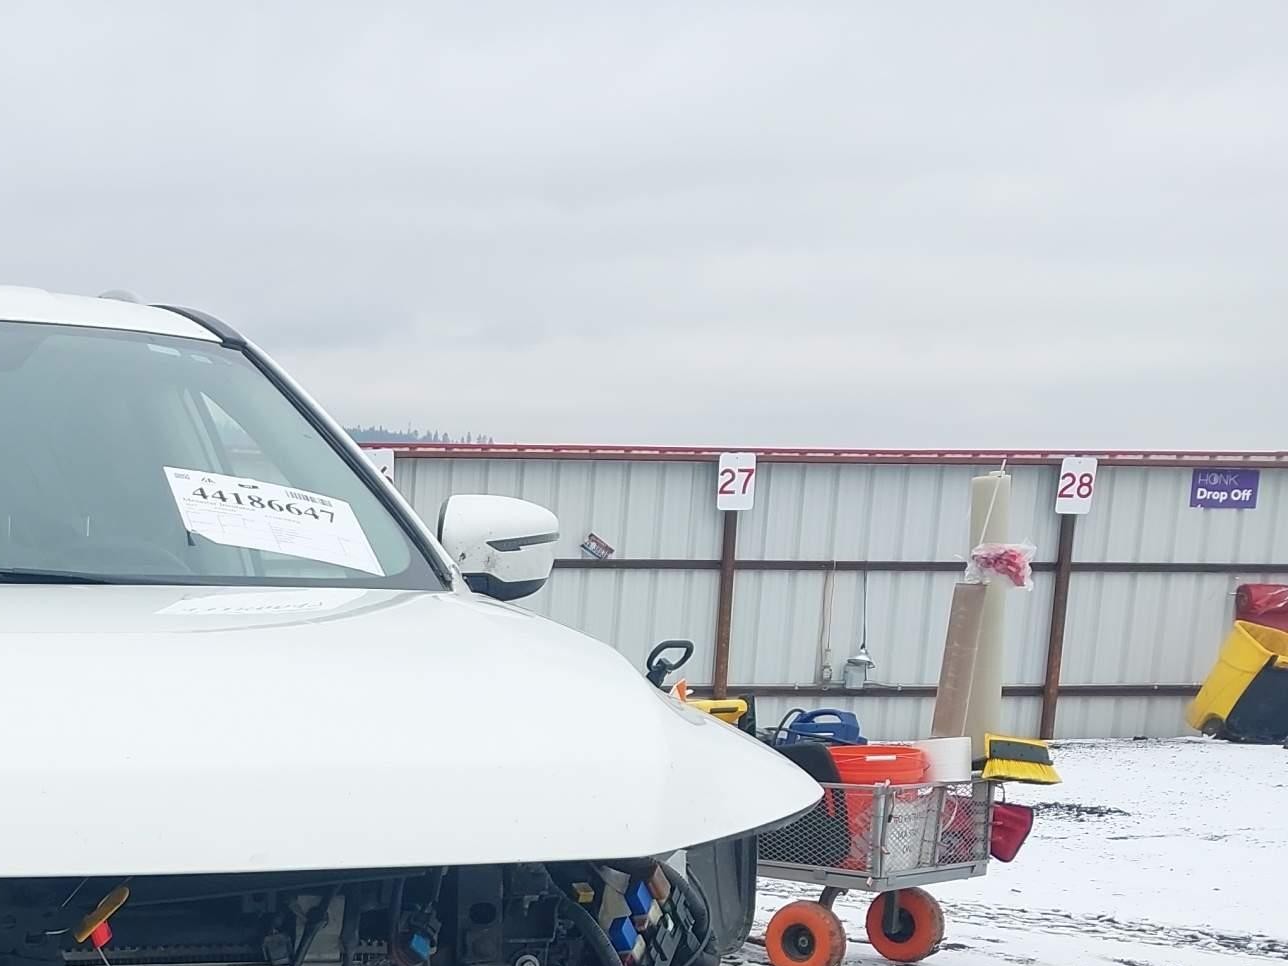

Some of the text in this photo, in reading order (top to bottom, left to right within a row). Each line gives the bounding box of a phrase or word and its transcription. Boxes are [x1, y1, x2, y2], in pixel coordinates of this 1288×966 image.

[719, 468, 754, 494] 27
[1058, 472, 1094, 499] 28
[1198, 472, 1239, 486] HONK
[192, 486, 335, 524] 44186647
[1196, 488, 1253, 503] Drop Off
